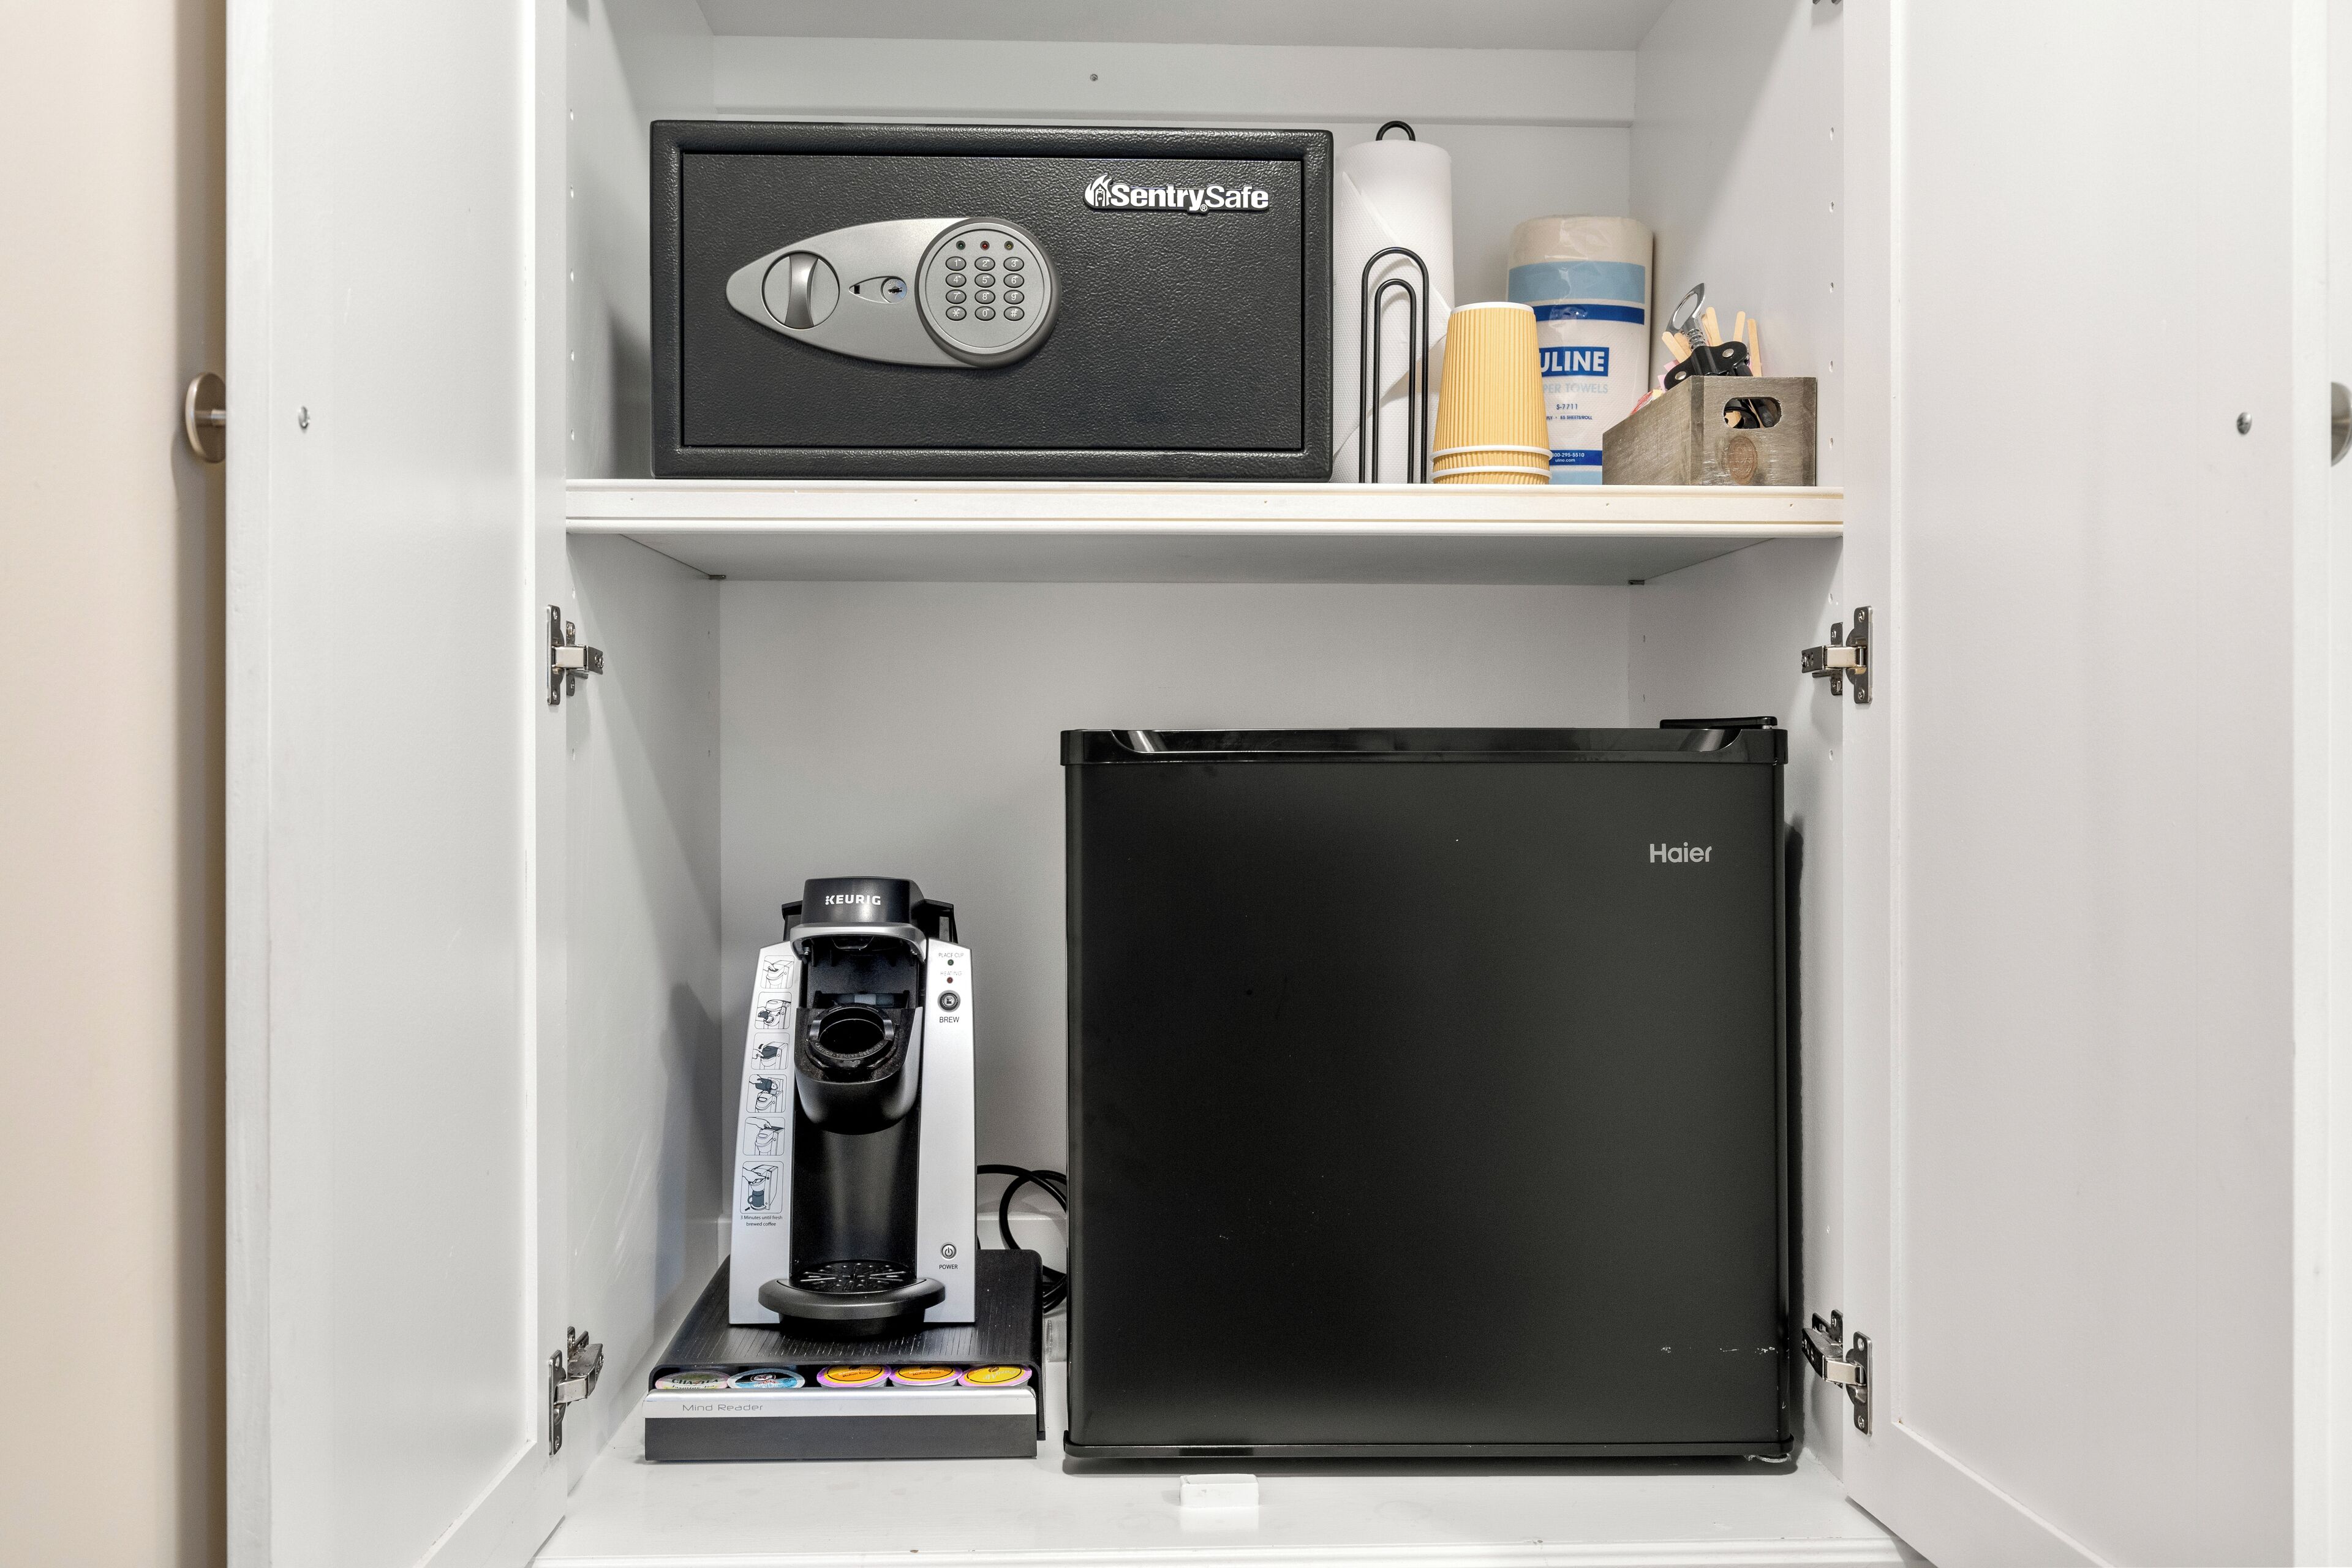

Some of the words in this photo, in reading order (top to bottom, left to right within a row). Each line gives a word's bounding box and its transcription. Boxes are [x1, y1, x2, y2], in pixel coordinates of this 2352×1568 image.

[1110, 184, 1269, 211] SentrySafe
[1539, 351, 1605, 372] ULINE
[1542, 383, 1561, 393] PER
[1565, 382, 1608, 393] TOWELS
[1649, 842, 1713, 863] Haier
[825, 894, 881, 905] KEURIG
